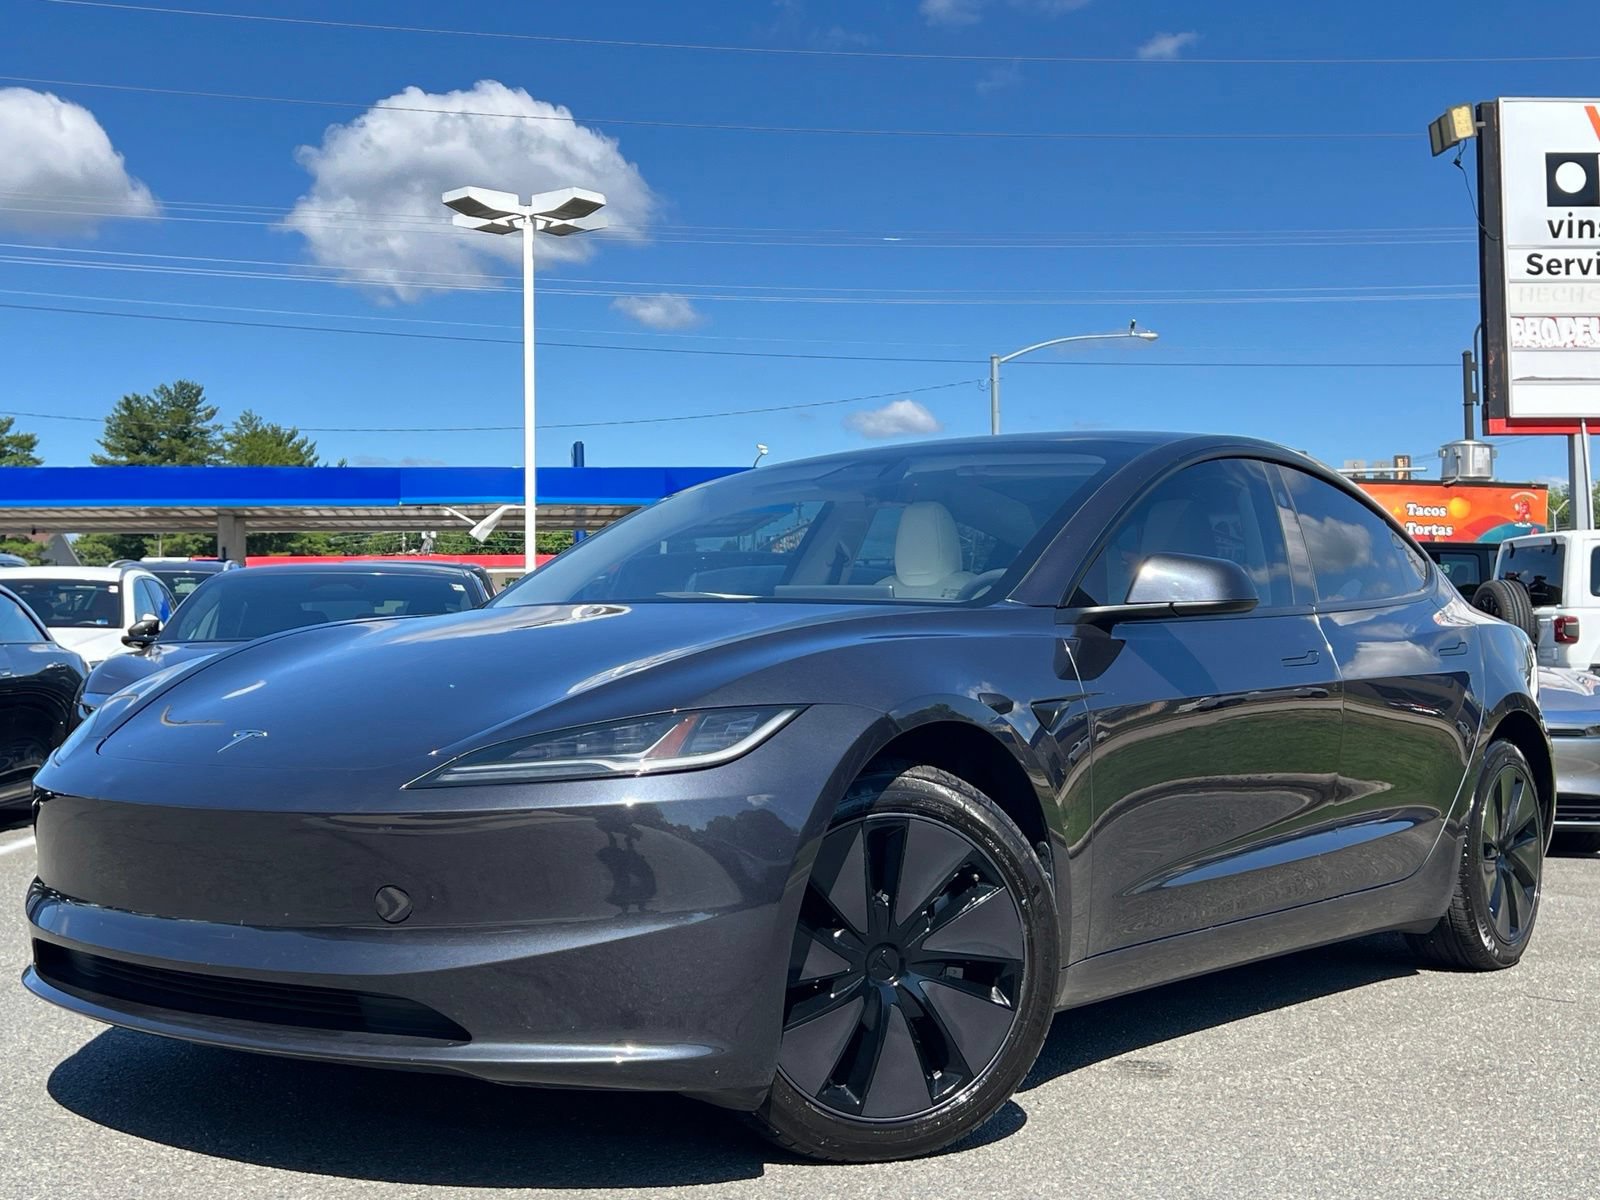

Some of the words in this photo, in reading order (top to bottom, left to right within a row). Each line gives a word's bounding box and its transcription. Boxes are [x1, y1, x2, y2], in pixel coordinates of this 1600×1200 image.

[1547, 211, 1600, 239] vin
[1405, 502, 1447, 517] Tacos
[1405, 521, 1454, 537] Tortas
